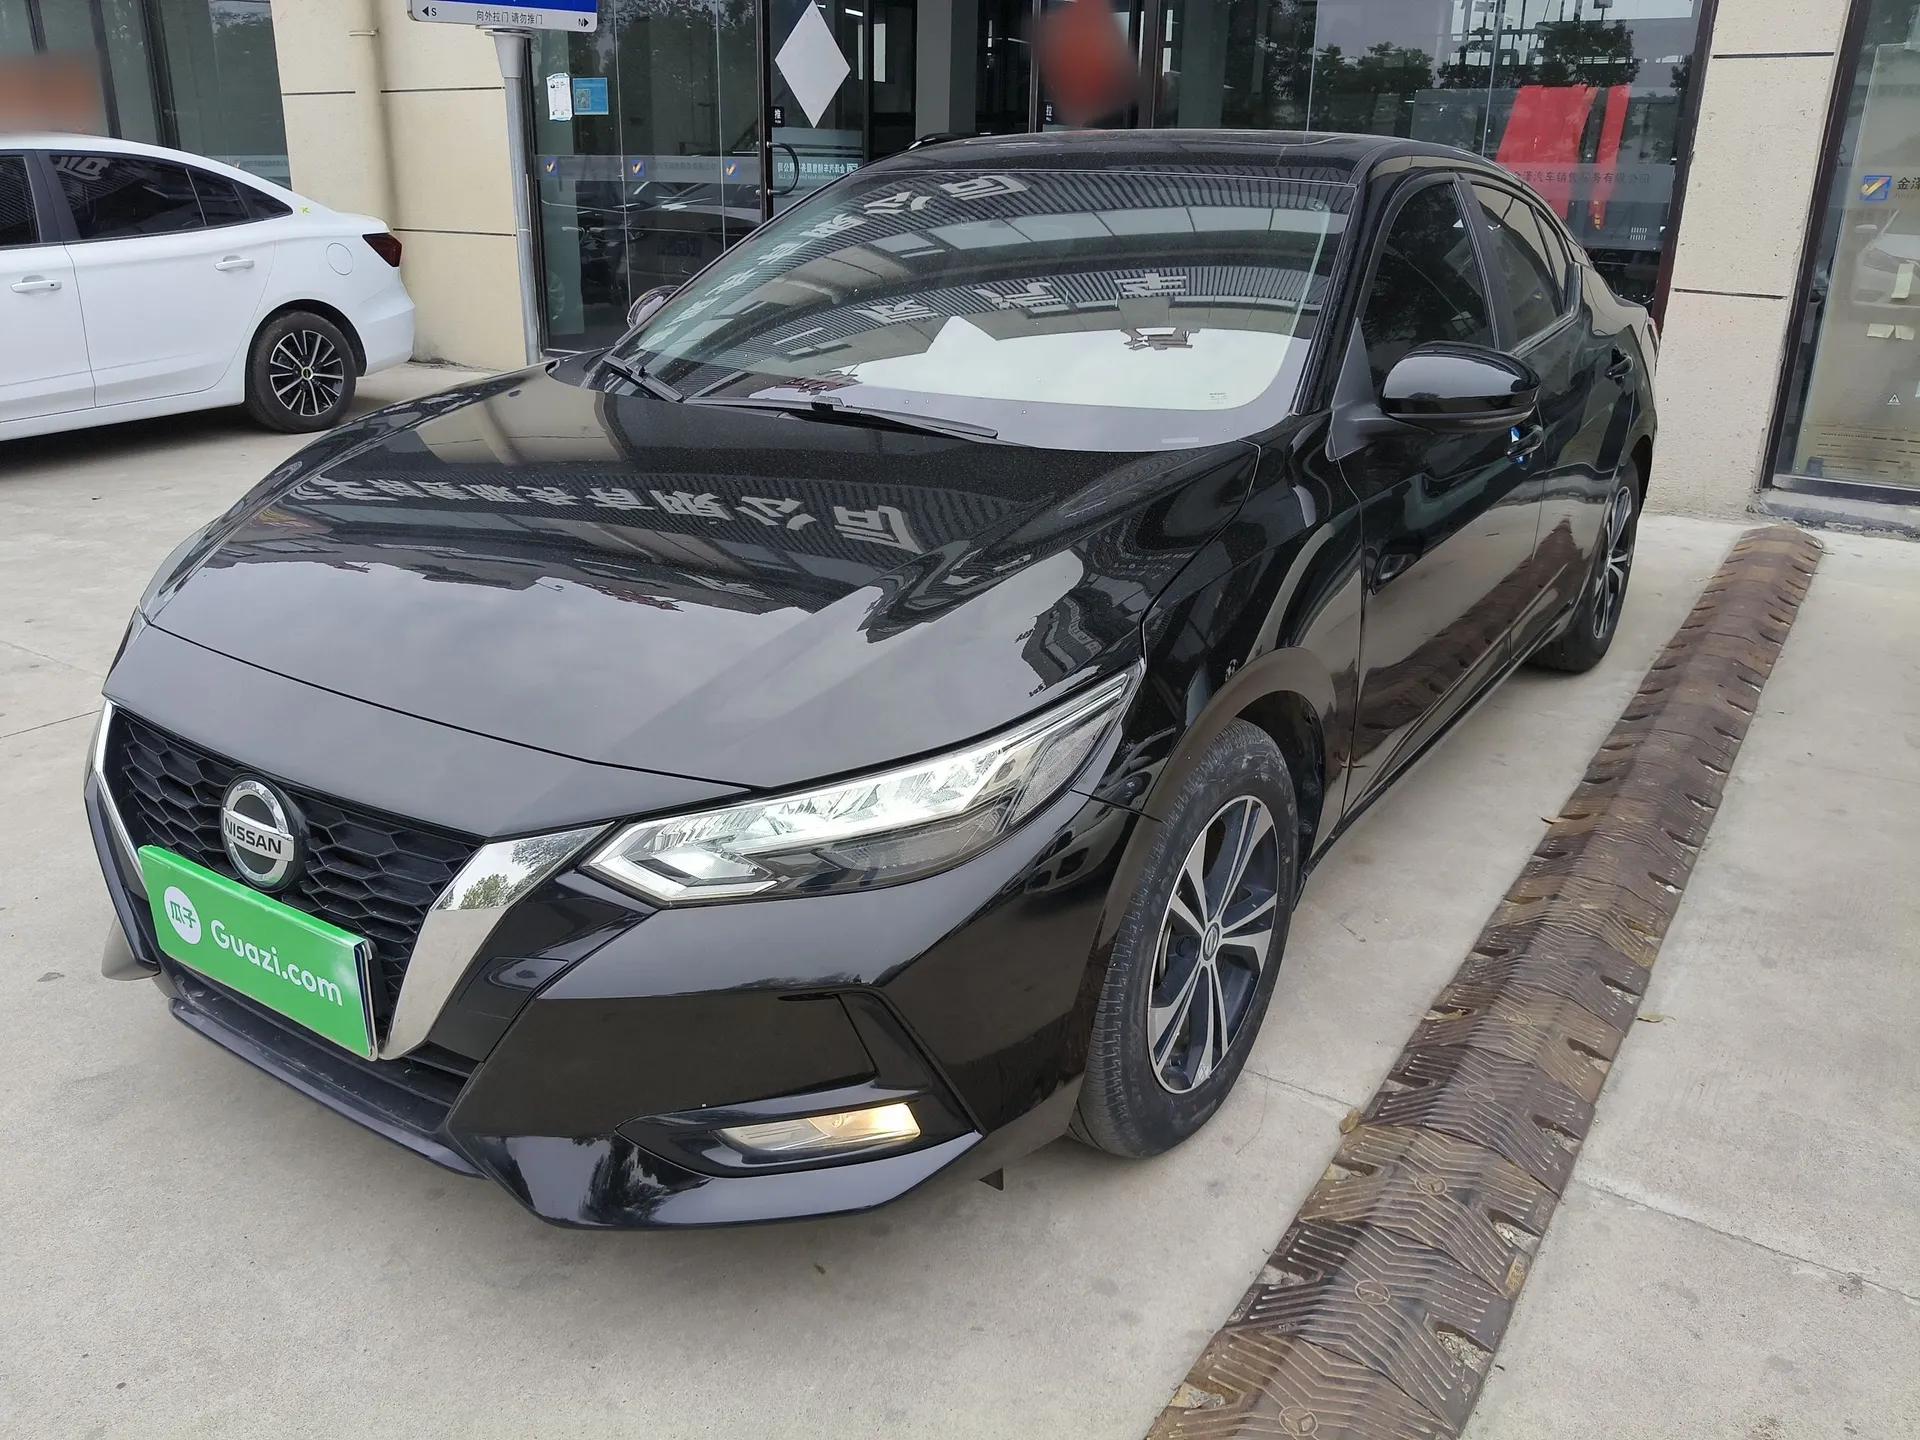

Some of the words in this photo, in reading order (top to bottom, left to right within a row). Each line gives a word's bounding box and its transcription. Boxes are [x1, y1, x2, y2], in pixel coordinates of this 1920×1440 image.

[431, 7, 437, 17] S
[476, 10, 509, 23] 向外拉门
[511, 12, 543, 25] 请勿推门
[225, 817, 281, 855] NISSAN
[169, 900, 197, 928] 瓜子
[210, 919, 344, 1007] Guazi.com
